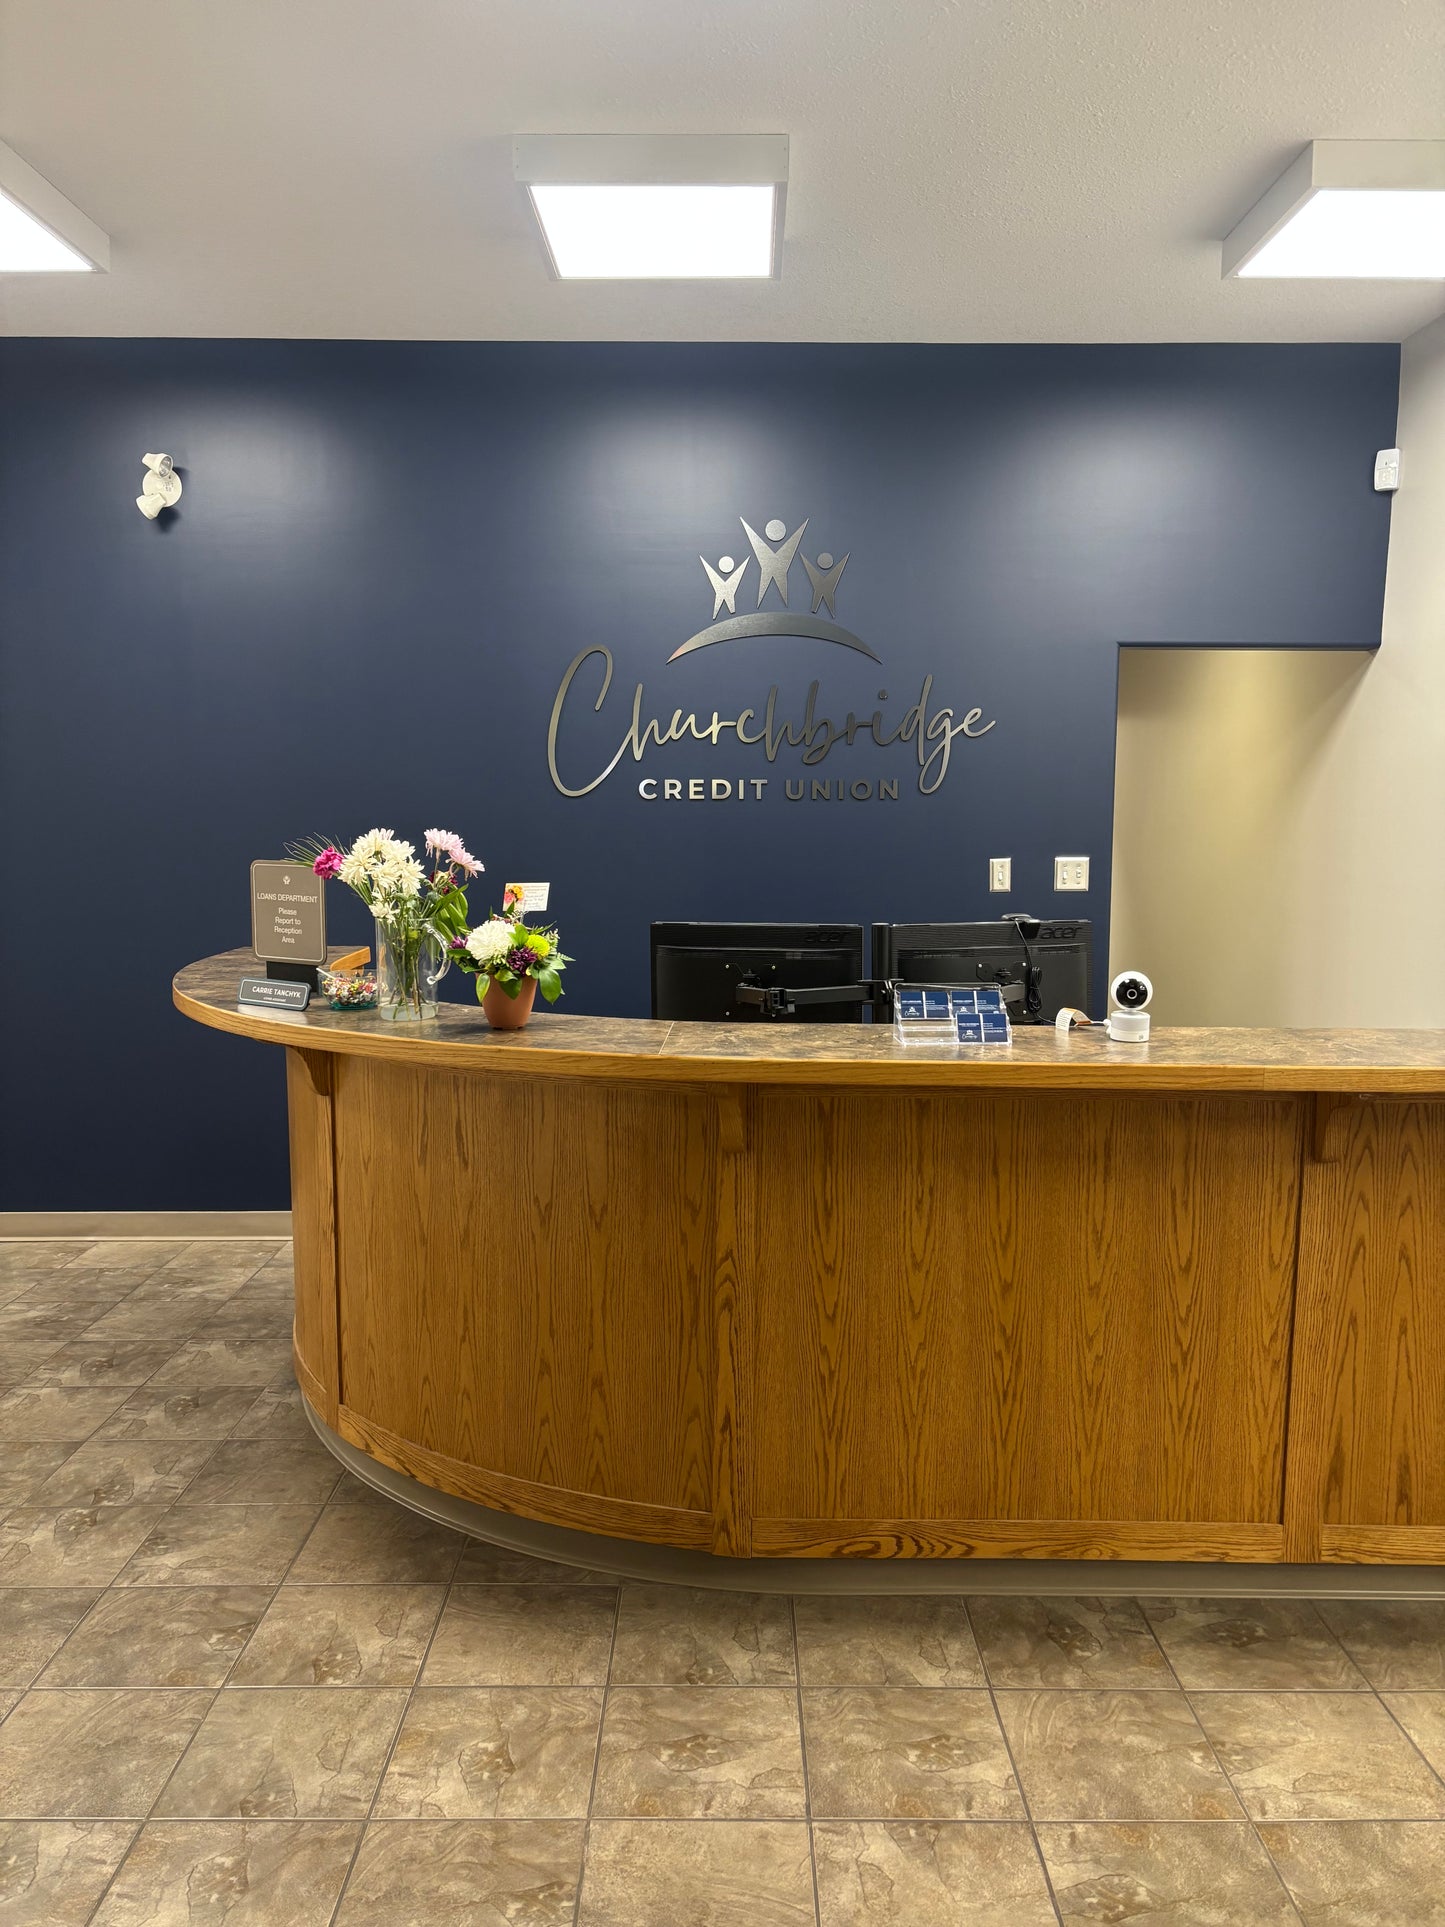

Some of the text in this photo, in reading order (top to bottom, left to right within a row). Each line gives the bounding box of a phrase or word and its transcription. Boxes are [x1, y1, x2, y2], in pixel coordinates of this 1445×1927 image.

[547, 644, 996, 797] Churchbridge
[638, 778, 899, 801] CREDIT UNION
[257, 892, 318, 903] LOANS DEPARTMENT
[278, 907, 297, 916] Please
[275, 916, 302, 925] Report to
[274, 925, 302, 935] Reception
[1040, 926, 1082, 939] acer
[281, 936, 295, 944] Area
[804, 930, 850, 942] acer
[274, 988, 302, 998] TANCHYK
